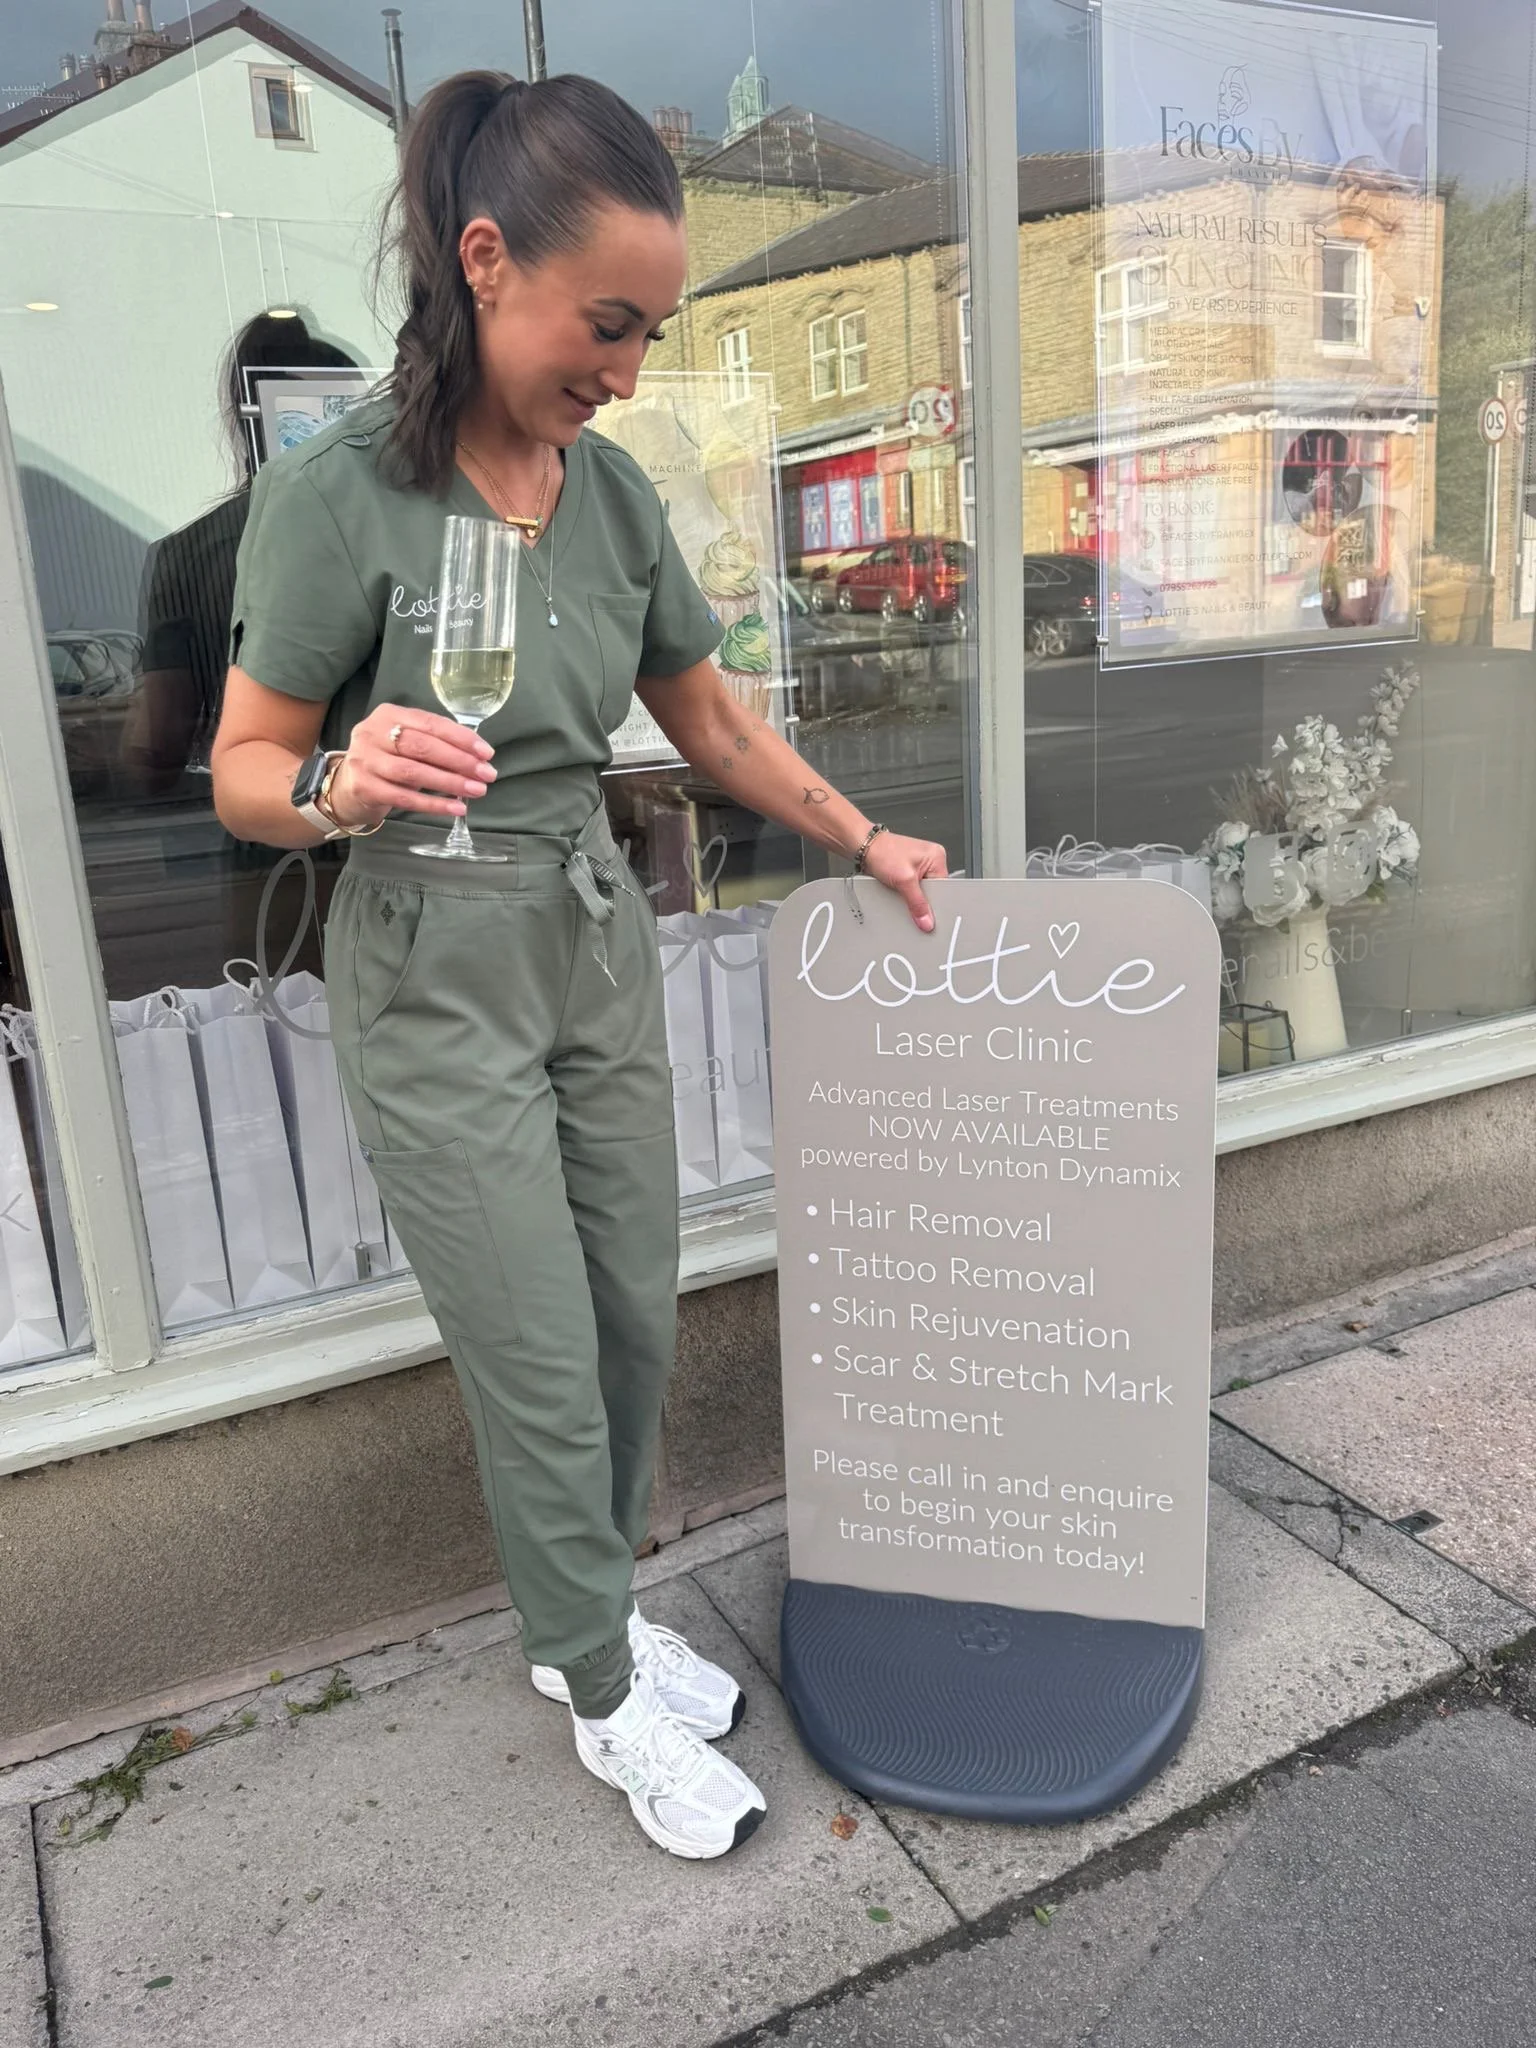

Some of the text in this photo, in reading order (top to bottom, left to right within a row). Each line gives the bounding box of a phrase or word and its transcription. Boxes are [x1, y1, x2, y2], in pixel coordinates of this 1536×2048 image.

[1135, 210, 1328, 248] NATURAL RESULTS
[1136, 245, 1217, 288] SKIN
[1185, 297, 1225, 313] YEARS
[1227, 299, 1298, 316] EXPERIENCE
[1149, 368, 1226, 378] NATURAL LOOKING
[1149, 381, 1203, 390] INJECTABLES
[1149, 395, 1170, 403] FULL
[1149, 407, 1195, 416] SPECIALIST
[1149, 421, 1176, 431] LASER
[649, 463, 702, 473] MACHINE
[414, 624, 433, 634] Nails
[797, 901, 1186, 1015] lottie
[876, 1023, 1092, 1063] Laser Clinic
[809, 1081, 1178, 1121] Advanced Laser Treatments
[870, 1115, 1110, 1150] NOW AVAILABLE
[802, 1148, 1180, 1187] powered by Lynton Dynamix
[831, 1198, 1050, 1241] Hair Removal
[829, 1248, 1093, 1296] Tattoo Removal
[833, 1297, 1129, 1350] Skin Rejuvenation
[834, 1345, 1173, 1405] Scar & Stretch Mark
[834, 1392, 1004, 1436] Treatment
[814, 1449, 1173, 1512] Please call in and enquire
[863, 1488, 1116, 1539] to begin your skin
[839, 1517, 1143, 1577] transformation today!
